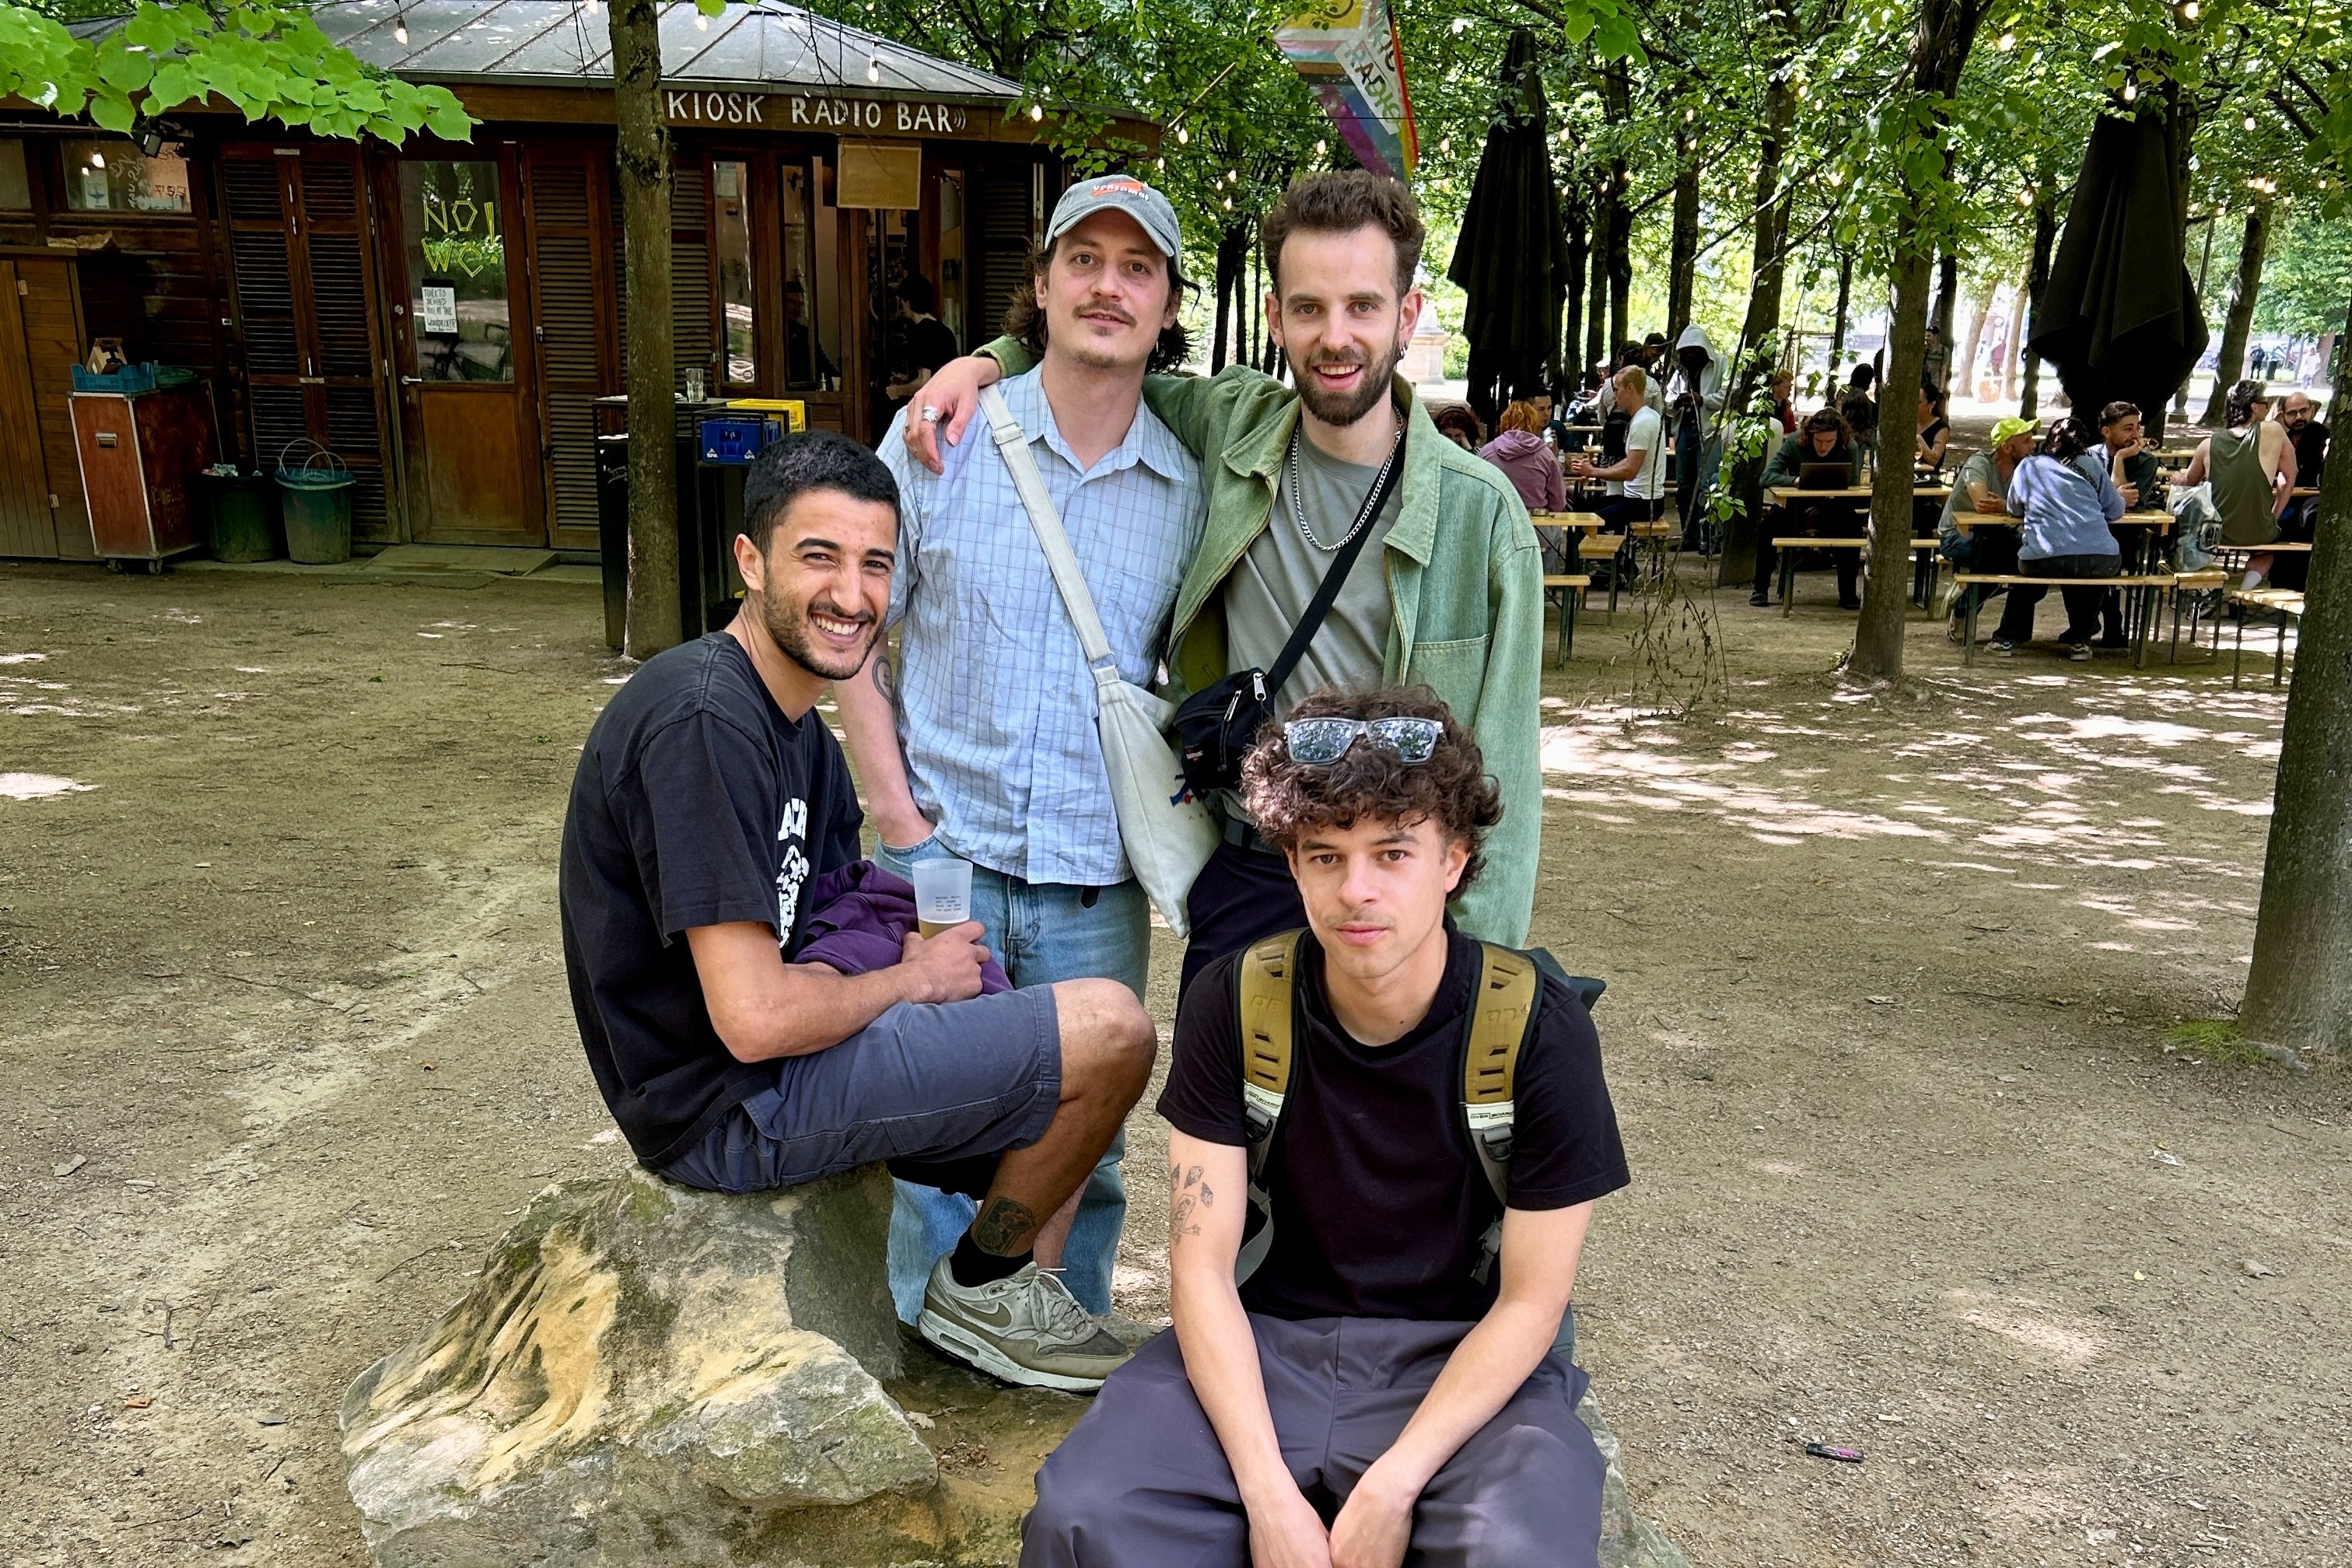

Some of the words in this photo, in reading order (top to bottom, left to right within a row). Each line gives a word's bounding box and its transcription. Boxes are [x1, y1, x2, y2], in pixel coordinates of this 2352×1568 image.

[1344, 41, 1400, 124] RADIO
[667, 91, 765, 124] KIOSK
[791, 96, 882, 128] RADIO
[897, 102, 953, 133] BAR
[421, 239, 484, 278] WC
